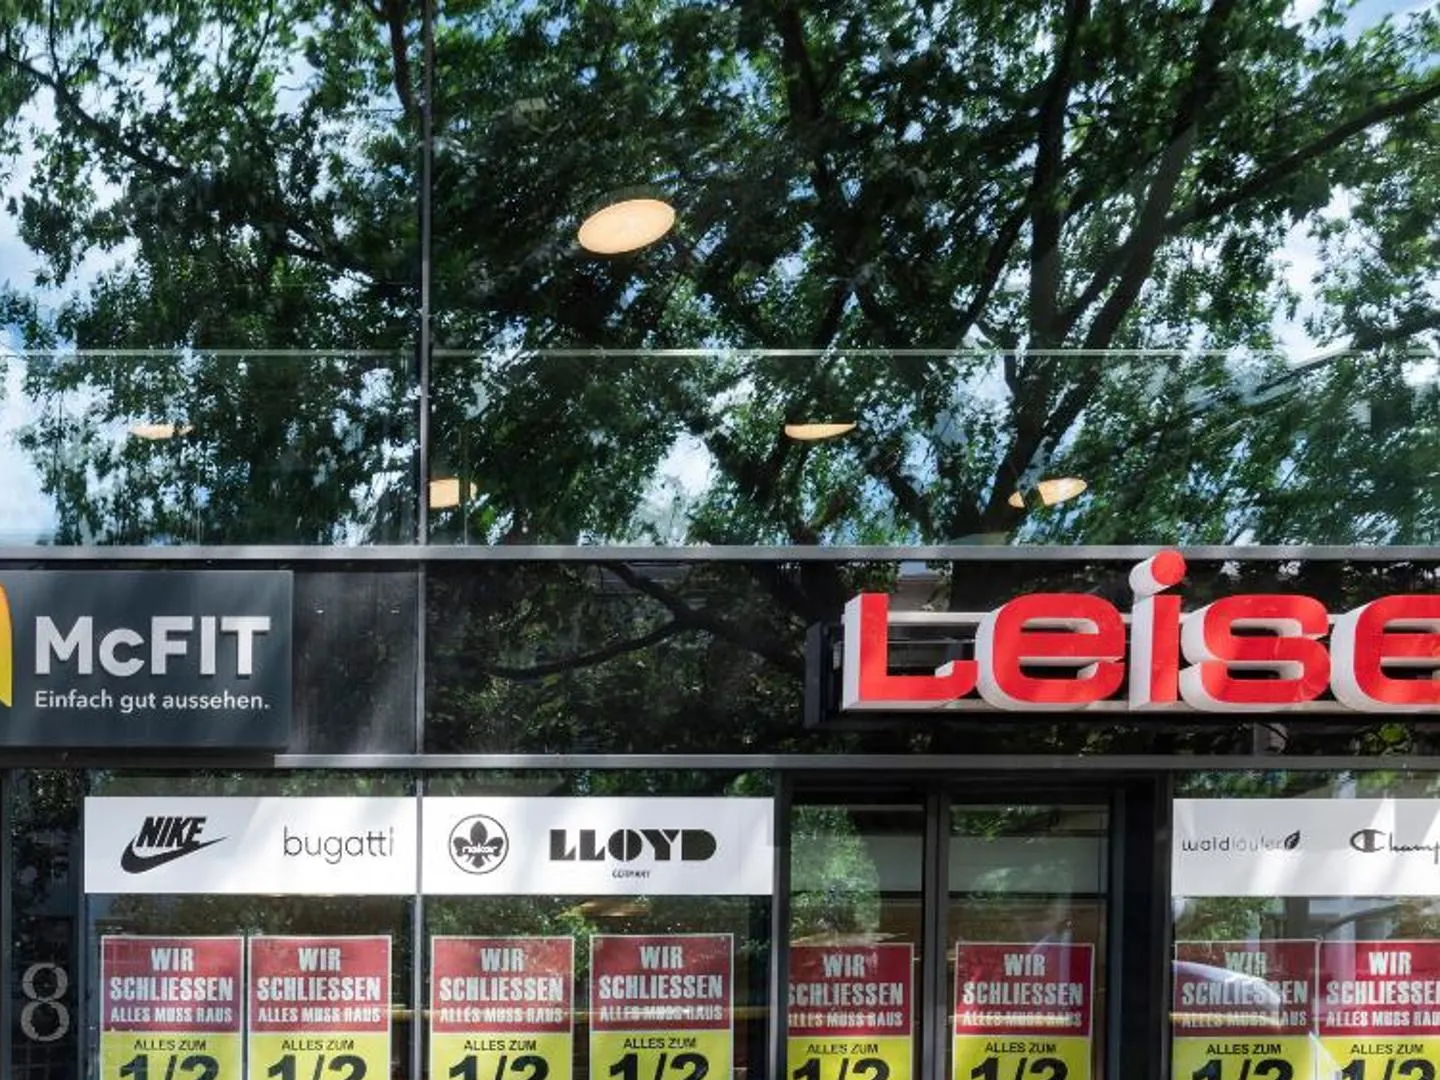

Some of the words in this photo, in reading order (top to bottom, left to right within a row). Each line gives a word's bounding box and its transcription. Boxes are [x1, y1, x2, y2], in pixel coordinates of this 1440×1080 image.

[843, 550, 1440, 712] Leise
[35, 615, 271, 677] McFIT
[35, 690, 113, 708] Einfach
[121, 691, 156, 713] gut
[163, 690, 270, 710] aussehen.
[136, 816, 208, 847] NIKE
[283, 826, 395, 865] bugatti
[550, 829, 717, 861] LLOYD
[152, 948, 194, 972] WIR
[298, 948, 341, 972] WIR
[480, 948, 525, 972] WIR
[640, 946, 683, 969] WIR
[824, 954, 865, 978] WIR
[1004, 953, 1045, 976] WIR
[1225, 952, 1268, 976] WIR
[1368, 952, 1412, 976] WIR
[110, 977, 233, 1001] SCHLIESSEN
[257, 977, 381, 1001] SCHLIESSEN
[439, 977, 564, 1001] SCHLIESSEN
[599, 975, 723, 999] SCHLIESSEN
[963, 982, 1084, 1006] SCHLIESSEN
[1326, 981, 1440, 1005] SCHLIESSE
[21, 962, 70, 1042] 8
[686, 1006, 723, 1020] RAUS
[111, 1008, 150, 1022] ALLES
[155, 1008, 193, 1022] MUSS
[196, 1008, 233, 1022] RAUS
[258, 1007, 298, 1022] ALLES
[301, 1007, 340, 1022] MUSS
[344, 1007, 381, 1022] RAUS
[440, 1007, 482, 1022] ALLES
[484, 1007, 523, 1022] MUSS
[527, 1007, 562, 1022] RAUS
[827, 1011, 865, 1026] MUSS
[867, 1011, 904, 1026] RAUS
[1326, 1010, 1368, 1027] ALLES
[1414, 1010, 1440, 1026] RAU
[134, 1039, 176, 1050] ALLES
[178, 1039, 206, 1050] ZUM
[281, 1040, 323, 1051] ALLES
[326, 1040, 355, 1051] ZUM
[464, 1040, 505, 1051] ALLES
[510, 1040, 537, 1051] ZUM
[624, 1038, 665, 1049] ALLES
[668, 1038, 696, 1048] ZUM
[807, 1043, 848, 1055] ALLES
[850, 1043, 878, 1054] ZUM
[985, 1042, 1025, 1053] ALLES
[1029, 1042, 1057, 1053] ZUM
[1206, 1044, 1249, 1055] ALLES
[1252, 1044, 1282, 1055] ZUM
[1351, 1044, 1393, 1055] ALLES
[1397, 1044, 1424, 1055] ZUM
